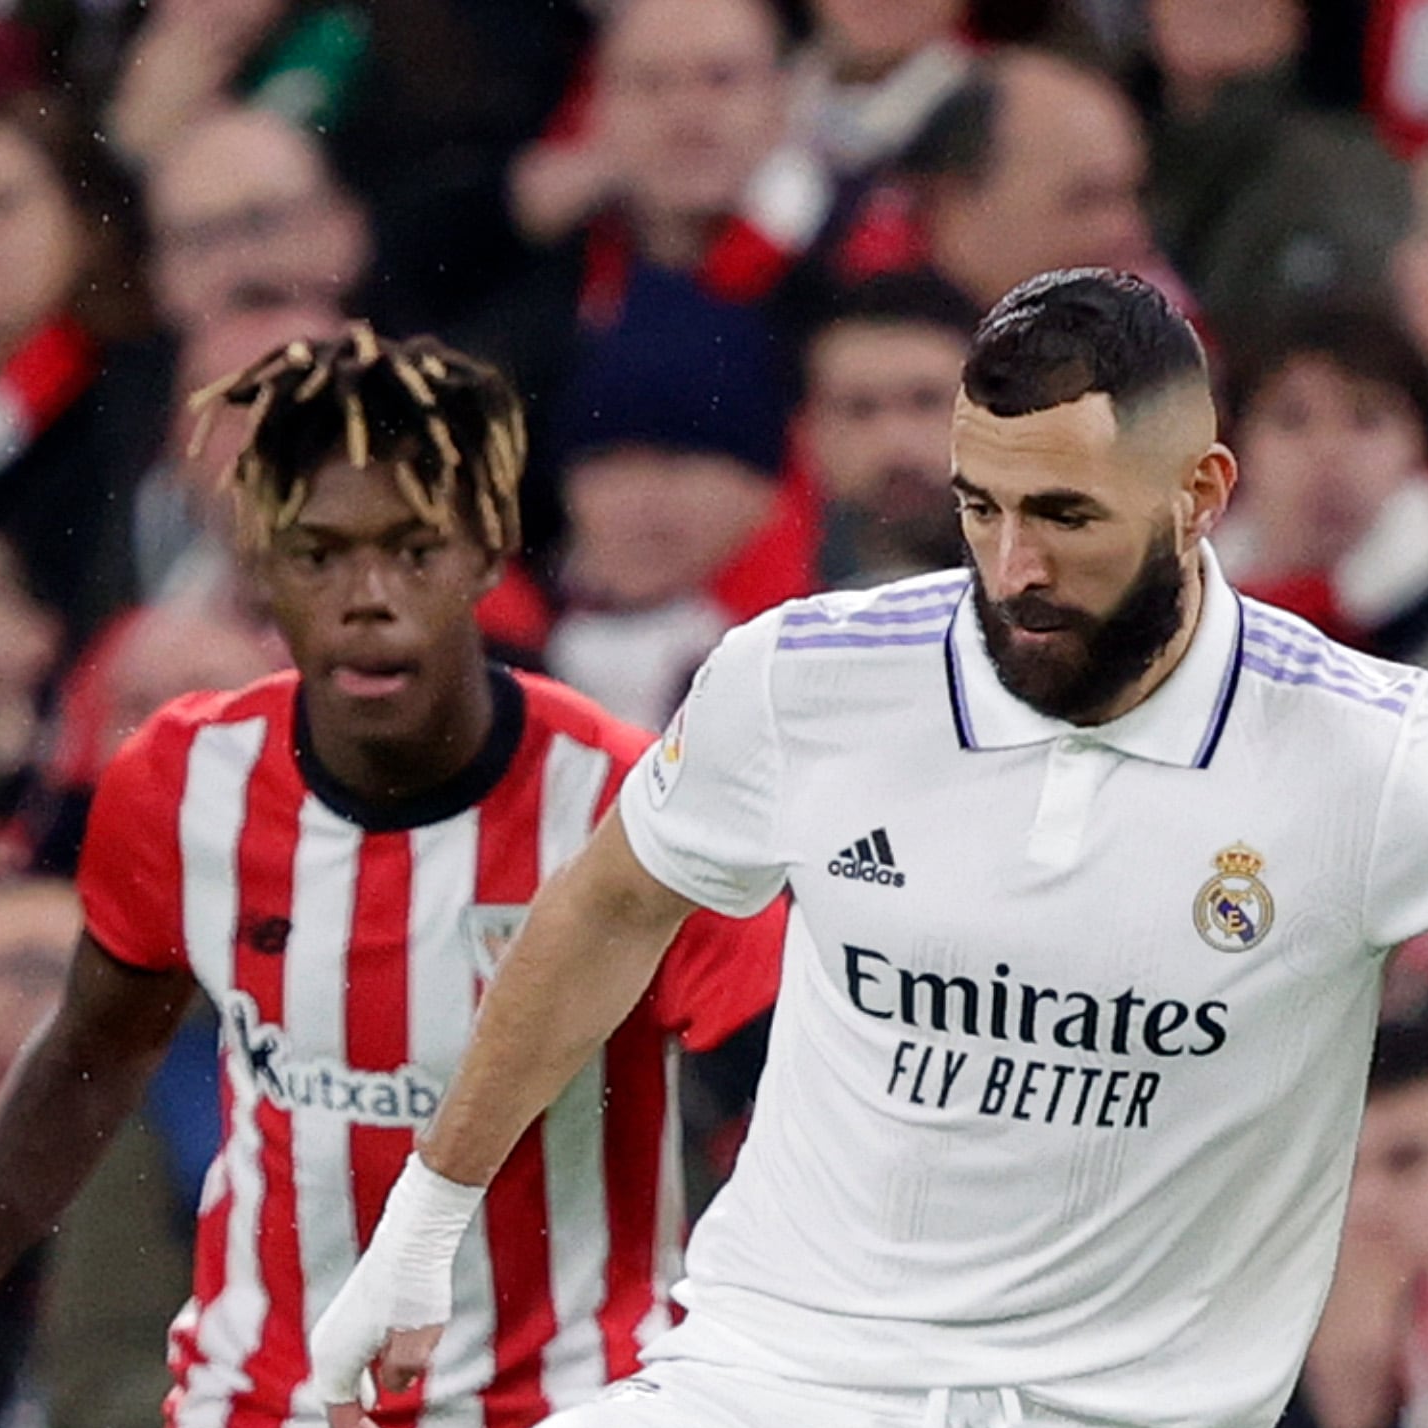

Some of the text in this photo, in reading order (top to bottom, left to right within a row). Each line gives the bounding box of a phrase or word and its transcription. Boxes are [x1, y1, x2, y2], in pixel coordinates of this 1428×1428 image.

[827, 859, 905, 888] adidas
[842, 943, 1229, 1058] Emirates
[232, 1001, 444, 1119] Kutxab
[886, 1040, 1161, 1128] FLY BETTER
